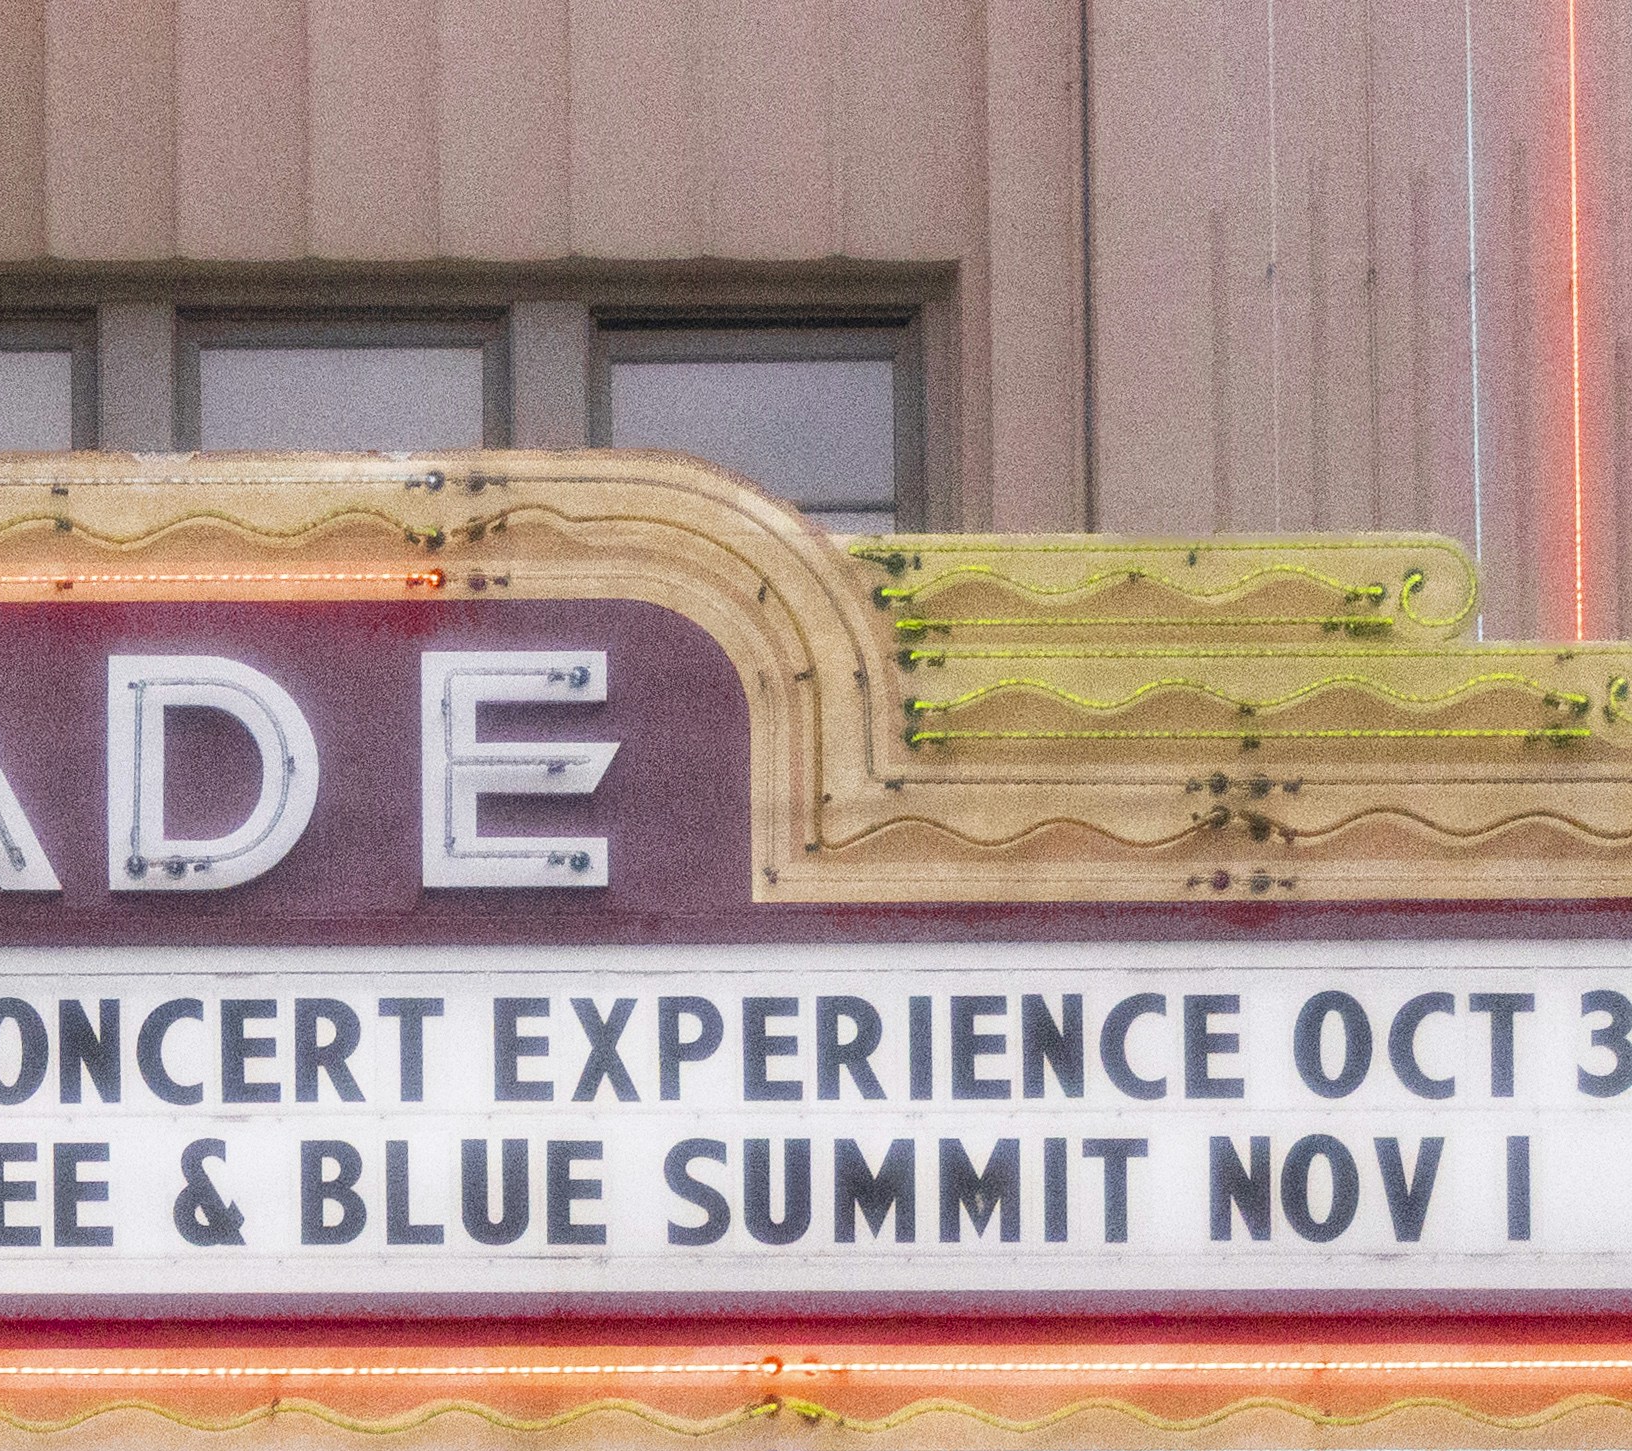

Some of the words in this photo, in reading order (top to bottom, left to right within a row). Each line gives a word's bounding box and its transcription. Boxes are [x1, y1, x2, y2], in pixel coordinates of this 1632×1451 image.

[495, 993, 1242, 1099] EXPERIENCE
[1295, 990, 1533, 1097] OCT
[174, 1139, 242, 1245] &
[302, 1140, 605, 1244] BLUE
[665, 1139, 1146, 1245] SUMMIT
[1211, 1134, 1442, 1242] NOV
[1509, 1137, 1529, 1239] 1
